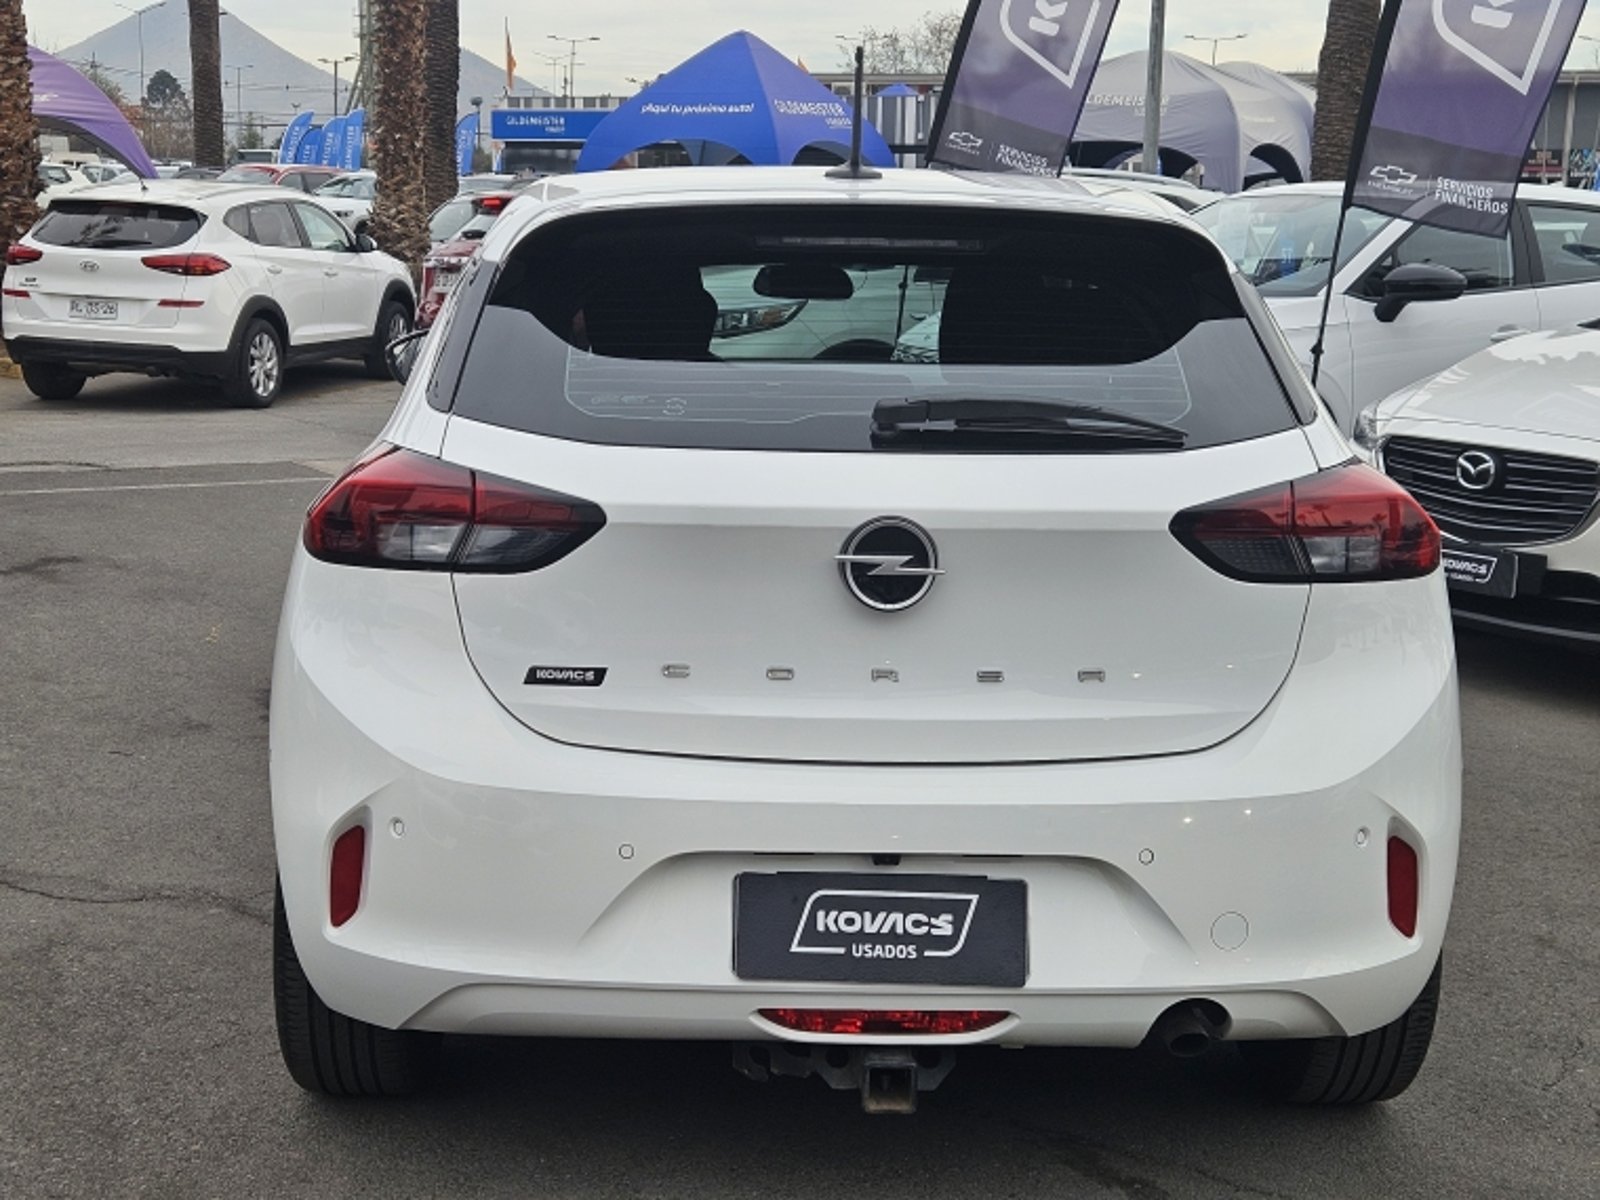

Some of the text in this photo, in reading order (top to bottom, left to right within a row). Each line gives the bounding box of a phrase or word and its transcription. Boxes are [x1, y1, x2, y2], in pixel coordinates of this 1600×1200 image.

[1436, 176, 1494, 198] SERVICIOS
[1434, 188, 1509, 214] FINANCIEROS
[536, 668, 595, 681] KOVACS
[661, 663, 1106, 683] CORSA
[816, 909, 955, 936] KOVACS
[851, 943, 918, 959] USADOS
